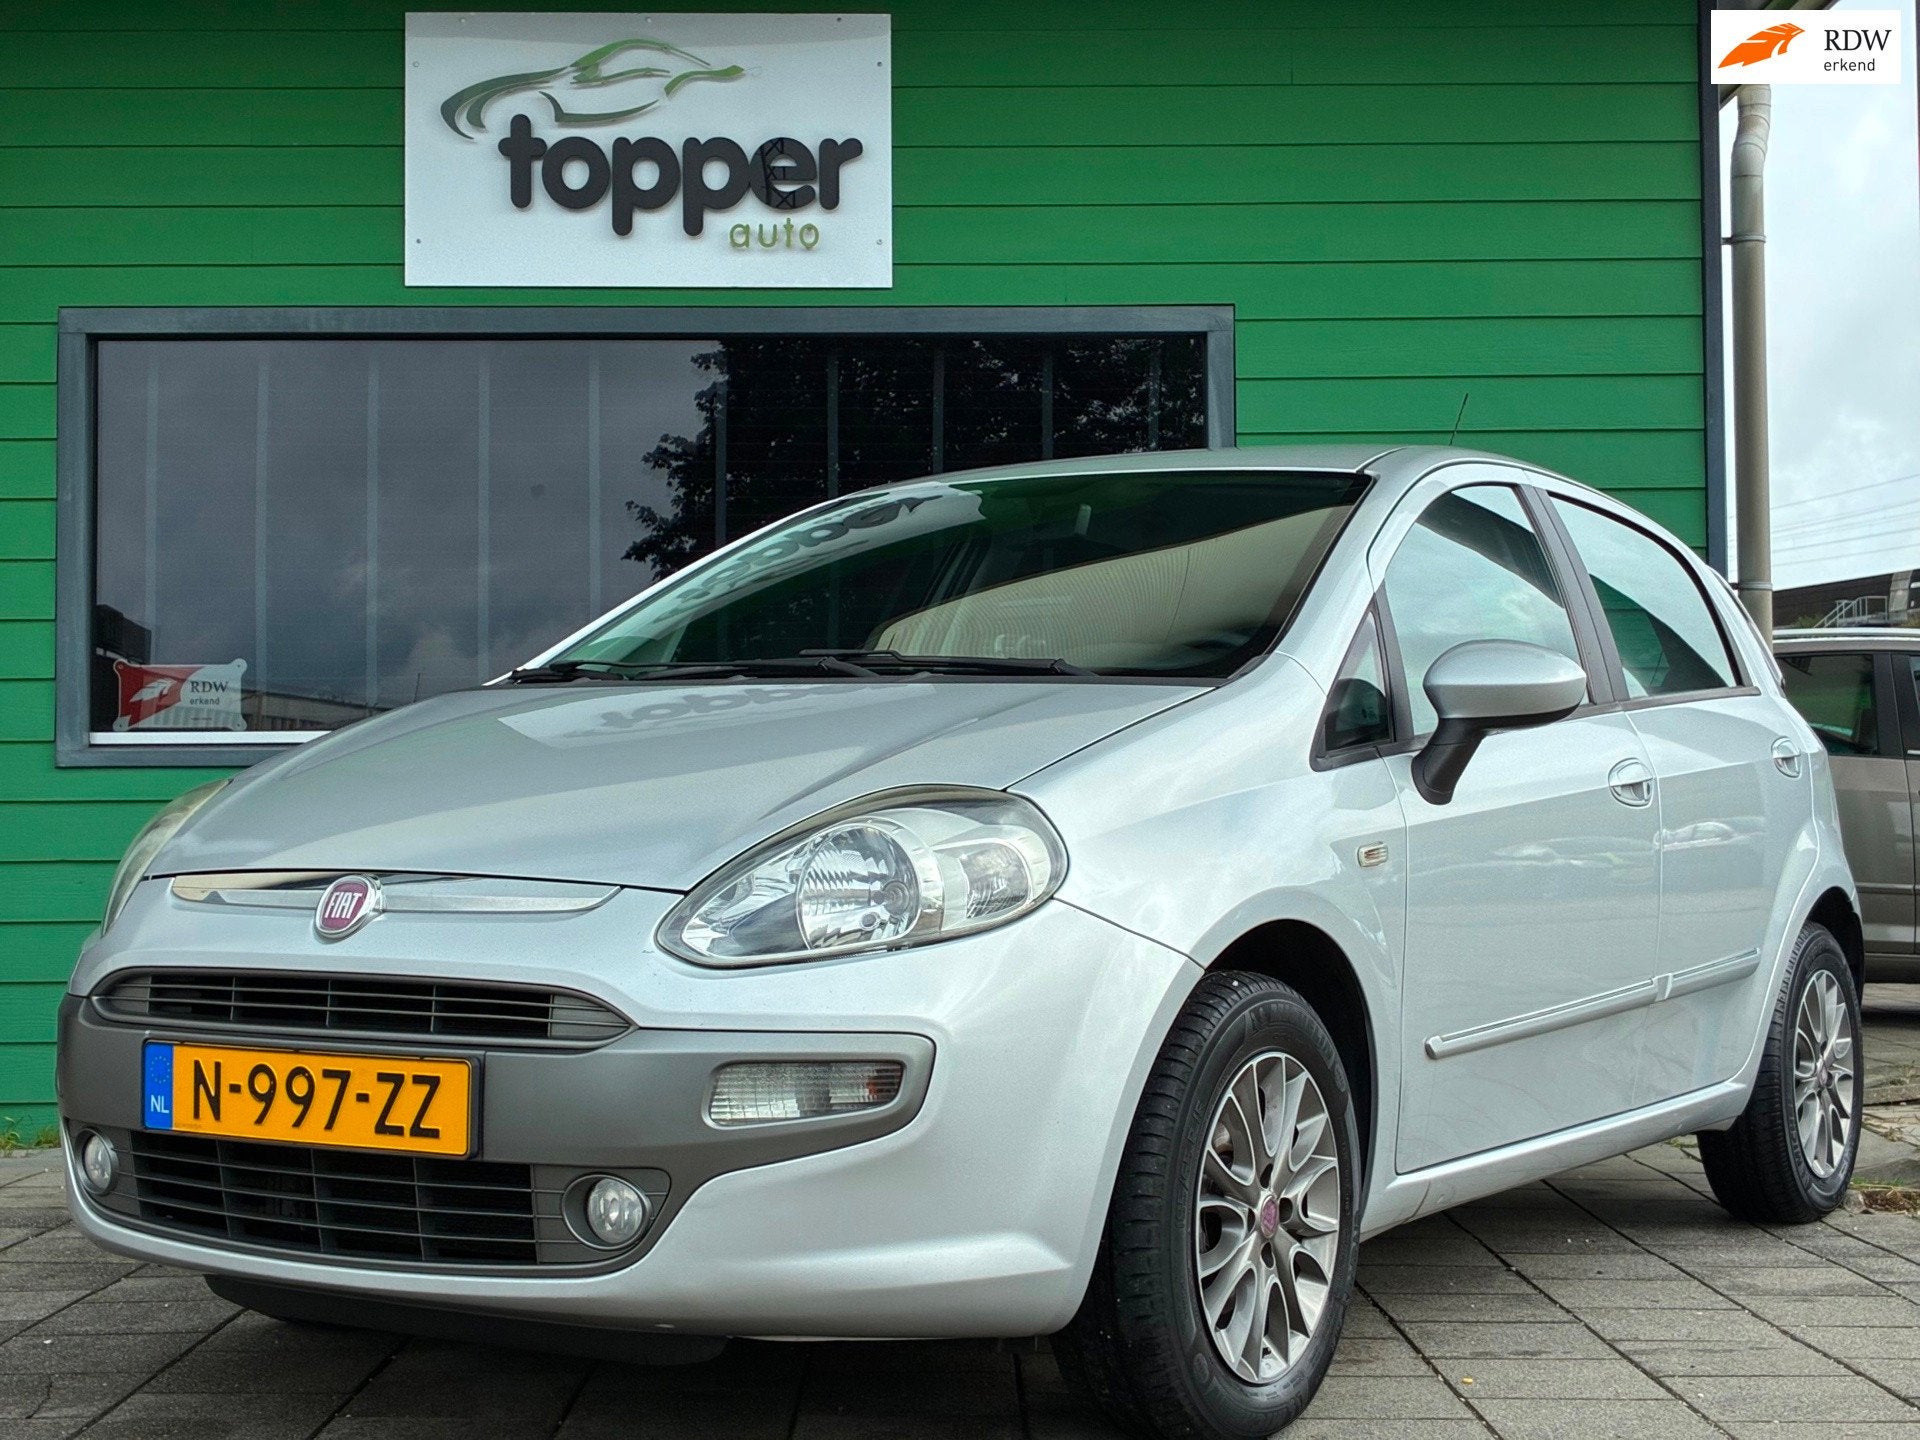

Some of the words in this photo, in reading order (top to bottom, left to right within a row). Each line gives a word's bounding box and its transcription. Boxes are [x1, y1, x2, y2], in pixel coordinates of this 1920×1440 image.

[498, 113, 863, 236] topper
[729, 217, 820, 249] auto
[189, 680, 229, 693] RDW
[189, 696, 220, 706] erkend
[324, 891, 363, 919] FIAT
[150, 1094, 170, 1115] NL
[192, 1059, 442, 1140] N-997-ZZ
